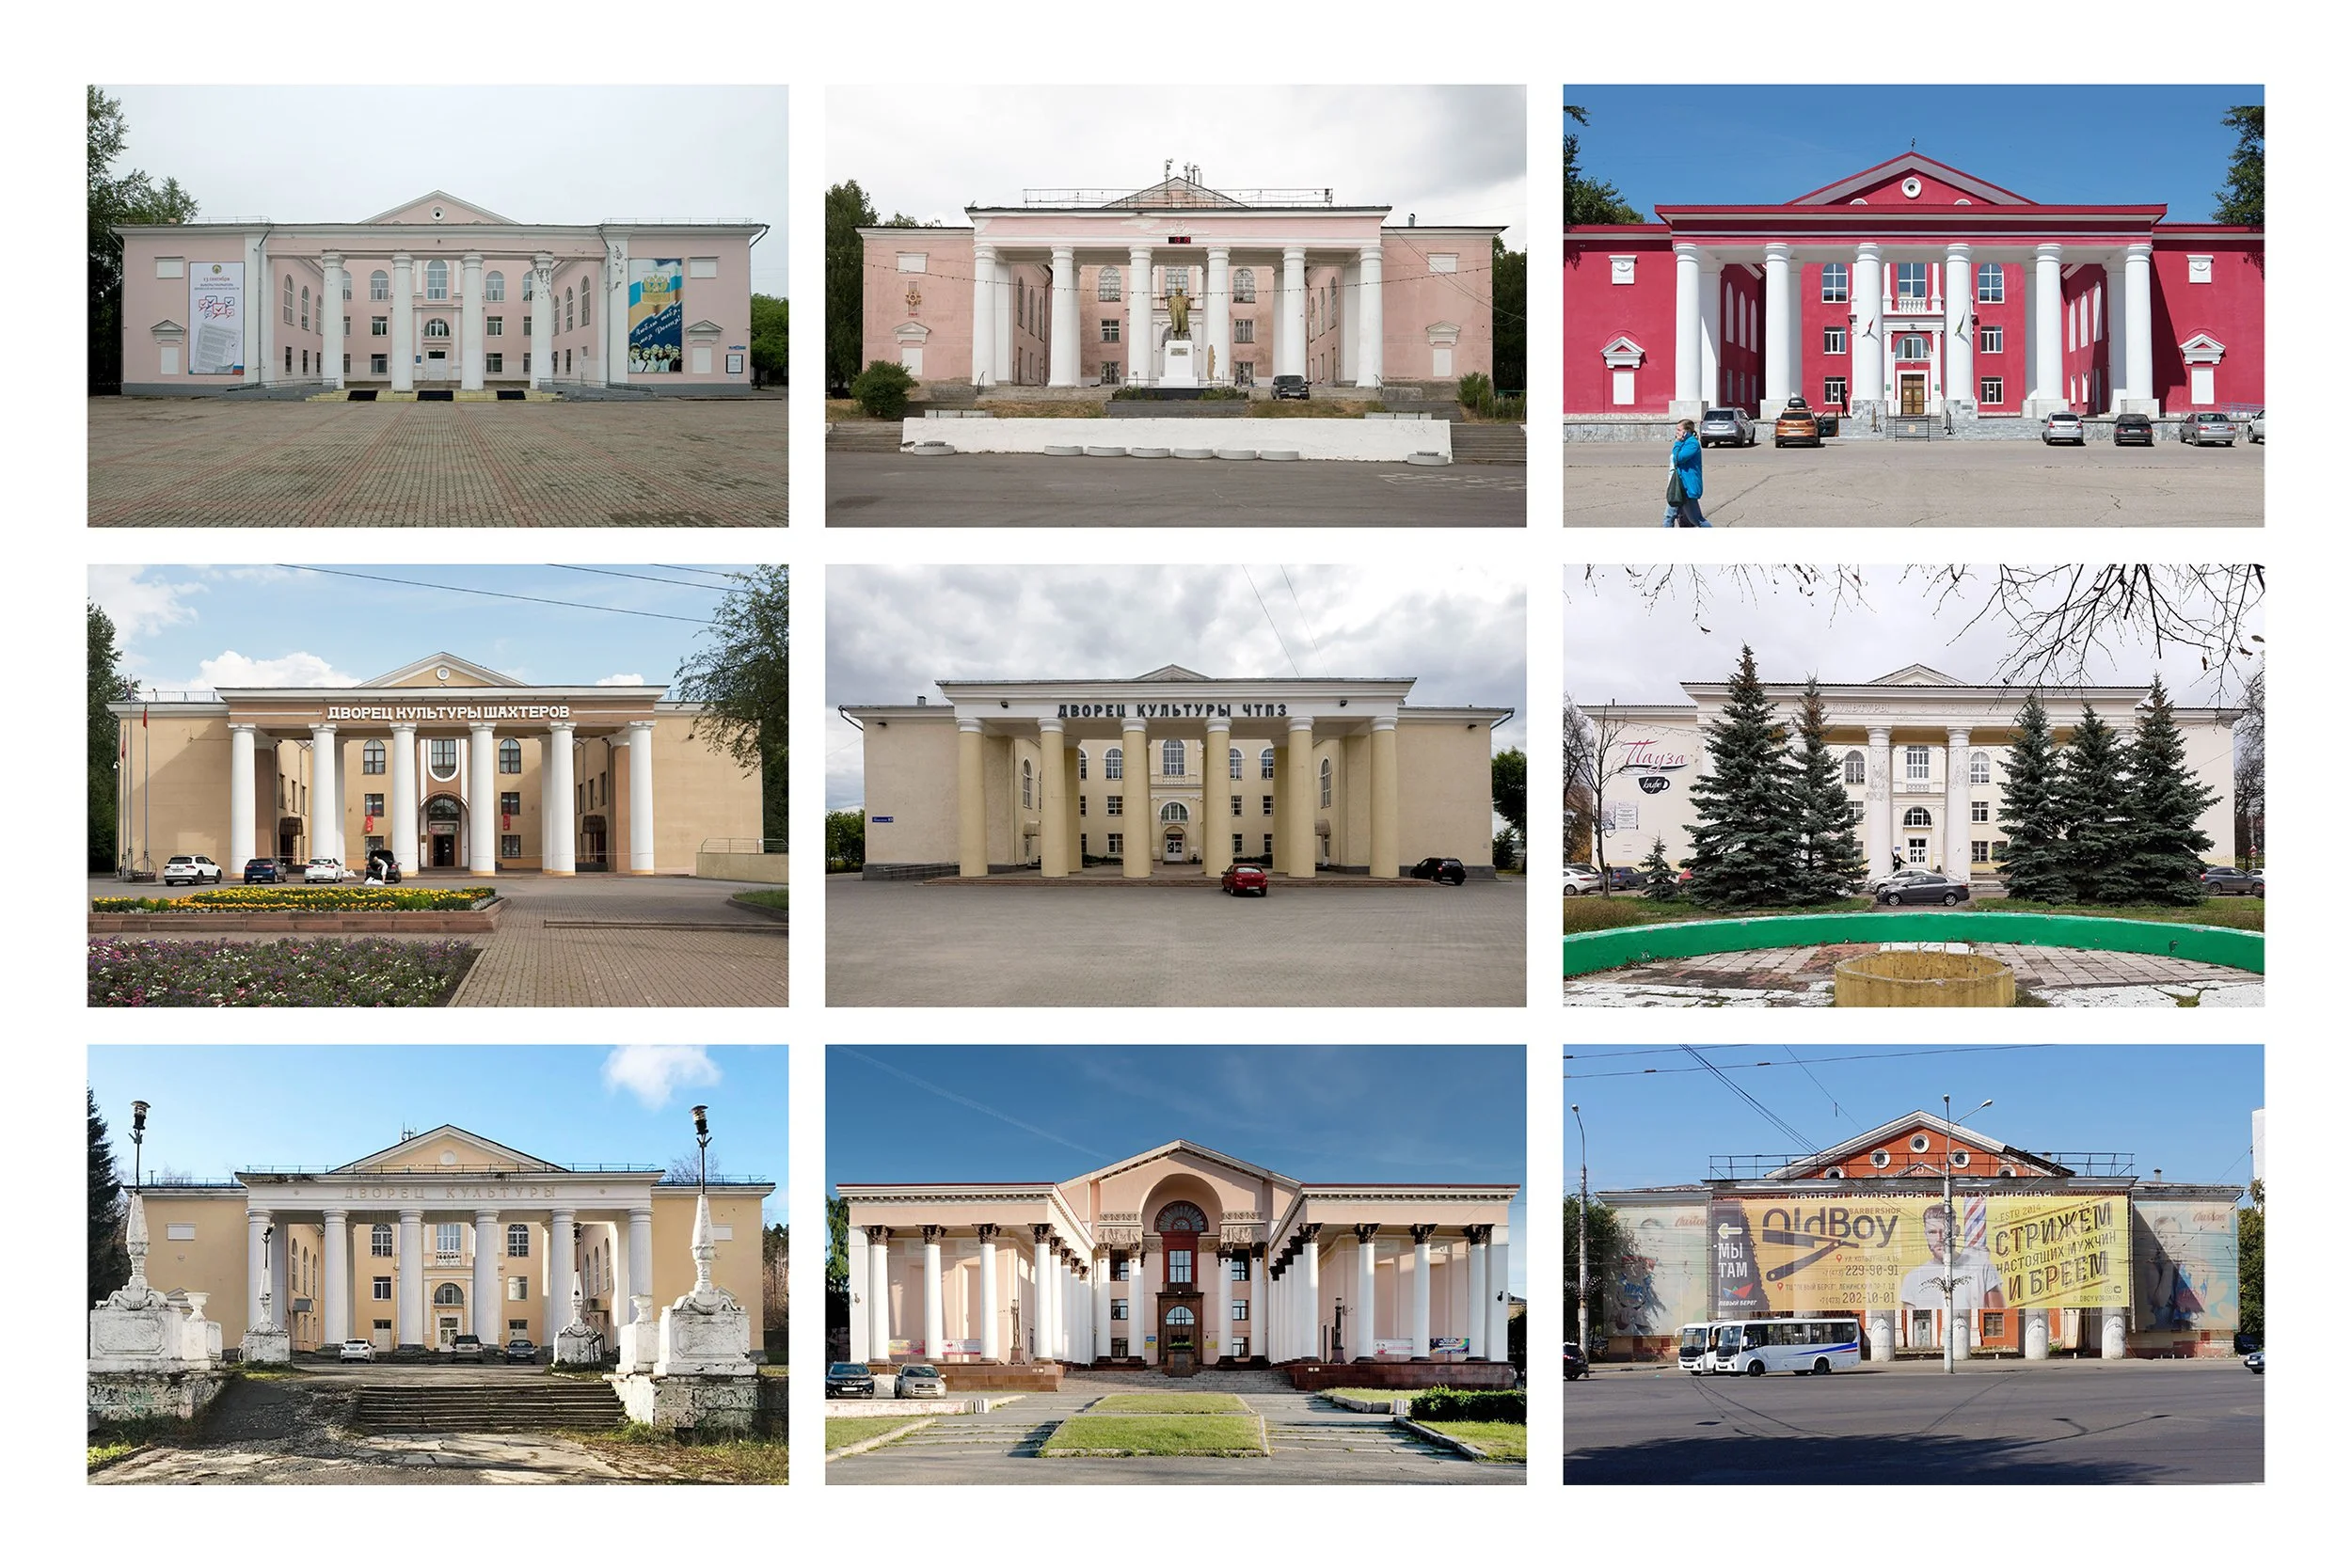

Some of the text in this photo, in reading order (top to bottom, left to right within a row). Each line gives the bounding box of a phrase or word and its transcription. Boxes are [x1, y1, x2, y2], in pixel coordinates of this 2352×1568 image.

[327, 705, 570, 720] ДВОРЕЦ КУЛЬТУРЫ ШАХТЕРОВ
[1057, 704, 1287, 718] ДВОРЕЦ КУЛЬТУРЫ ЧТПЗ
[1831, 703, 1889, 713] КУЛЬТУРЫ
[1620, 739, 1686, 775] Пауза
[344, 1187, 556, 1199] ДВОРЕЦ КУЛЬТУРЫ
[1762, 1207, 1899, 1248] OldBoy
[1995, 1201, 2112, 1258] СТРИЖЁМ
[1719, 1243, 1743, 1259] МЫ
[1996, 1231, 2116, 1275] НАСТОЯЩИХ МУЖЧИН
[1719, 1262, 1747, 1278] ТАМ
[1845, 1264, 1899, 1275] 229-90-91
[2009, 1250, 2108, 1303] И БРЕЕМ
[1842, 1292, 1896, 1304] 202-10-01
